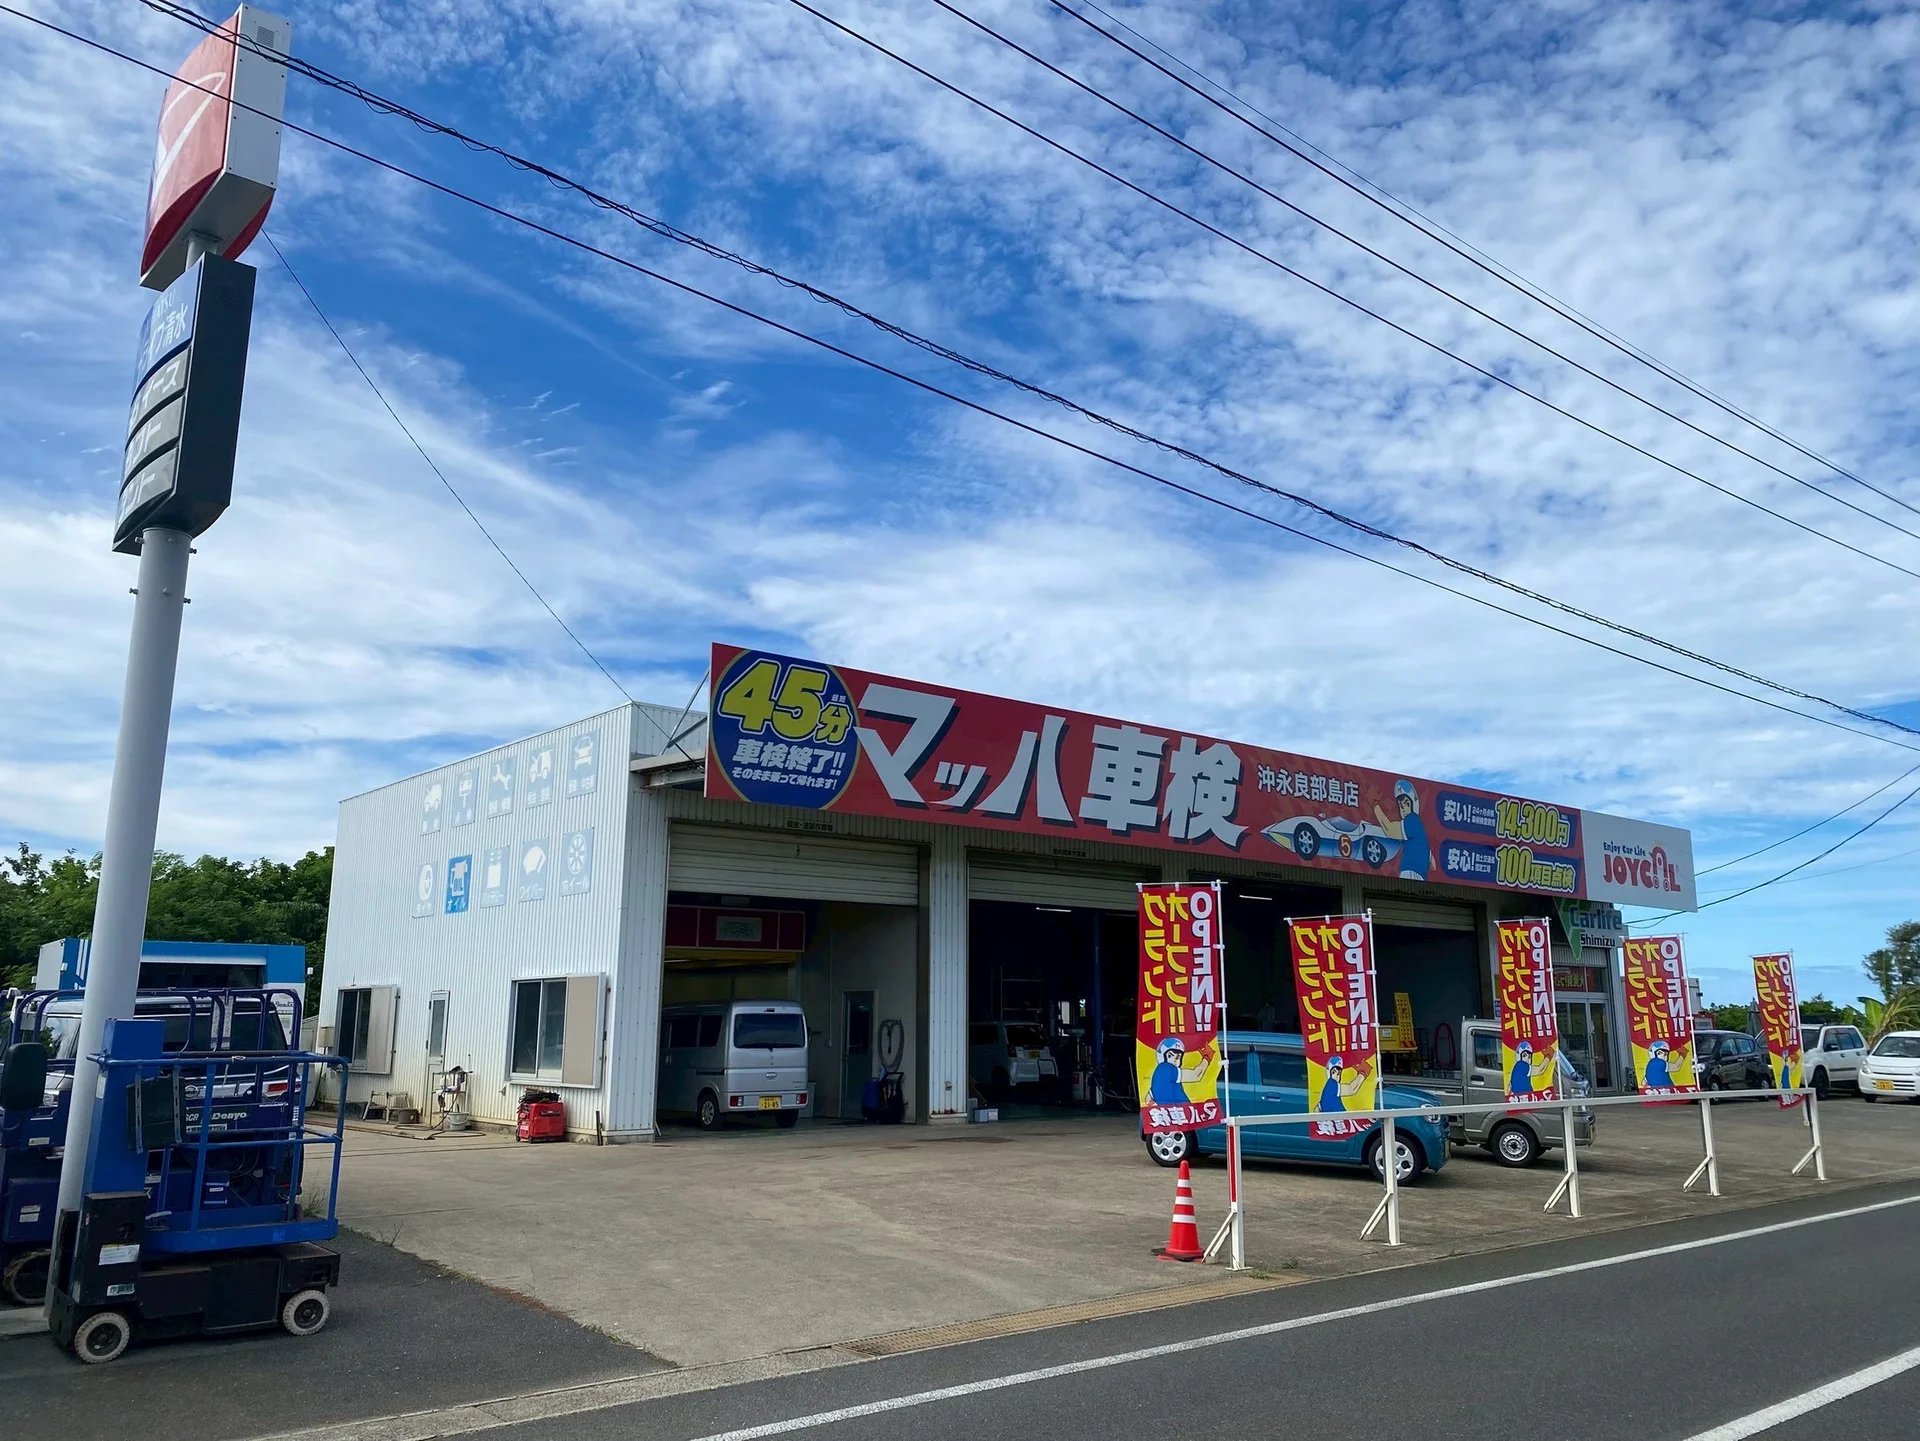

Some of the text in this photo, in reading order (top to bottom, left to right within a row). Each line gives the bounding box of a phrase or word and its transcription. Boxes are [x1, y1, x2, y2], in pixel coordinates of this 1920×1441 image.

[718, 658, 852, 744] 45分
[853, 683, 1249, 848] マッハ車検
[1256, 764, 1360, 808] 沖永良部島店
[1495, 797, 1570, 848] 14,300円
[1495, 844, 1576, 893] 100項目点検
[1603, 841, 1646, 856] Enjoy Car Life
[1603, 846, 1681, 892] JOYCAL
[1569, 906, 1622, 930] Carlife
[1581, 933, 1616, 947] Shimizu
[212, 1112, 248, 1122] Denyo
